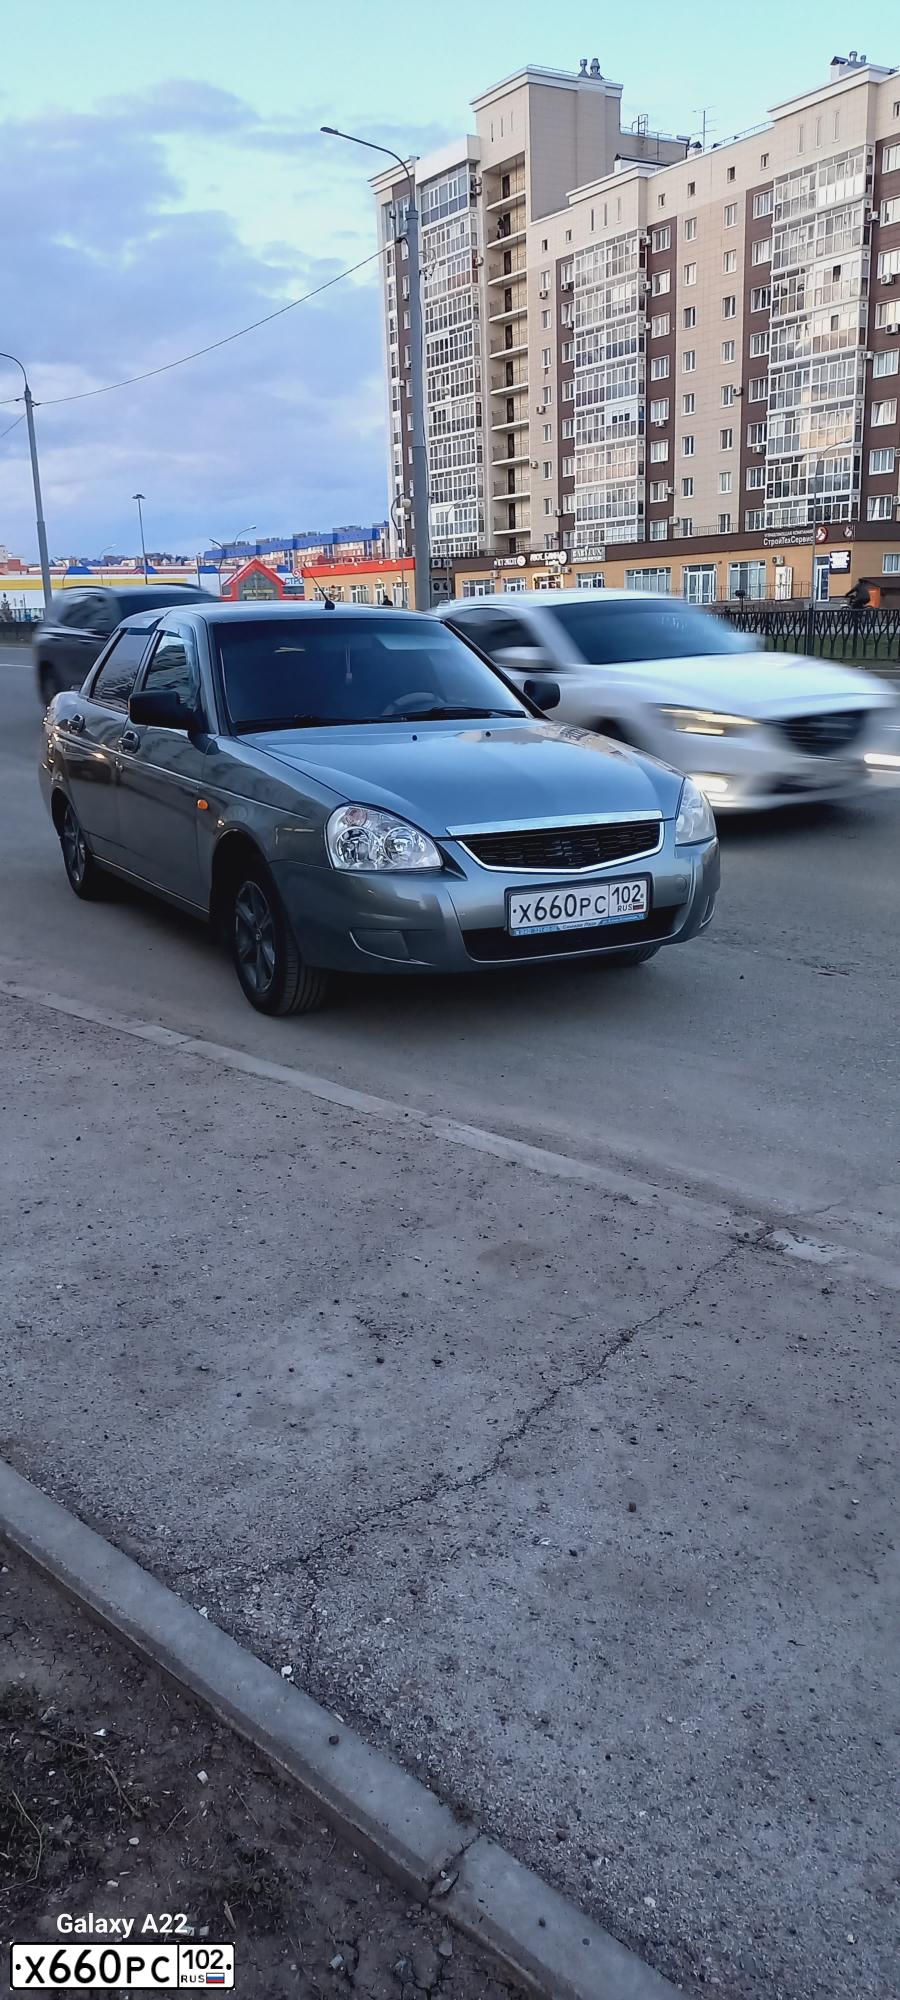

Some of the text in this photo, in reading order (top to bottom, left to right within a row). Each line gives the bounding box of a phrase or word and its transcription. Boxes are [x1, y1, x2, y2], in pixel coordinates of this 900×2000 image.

[763, 535, 814, 547] СтройТехСервис
[611, 884, 641, 905] 102
[518, 893, 607, 924] Х660РС
[617, 903, 633, 912] RUS
